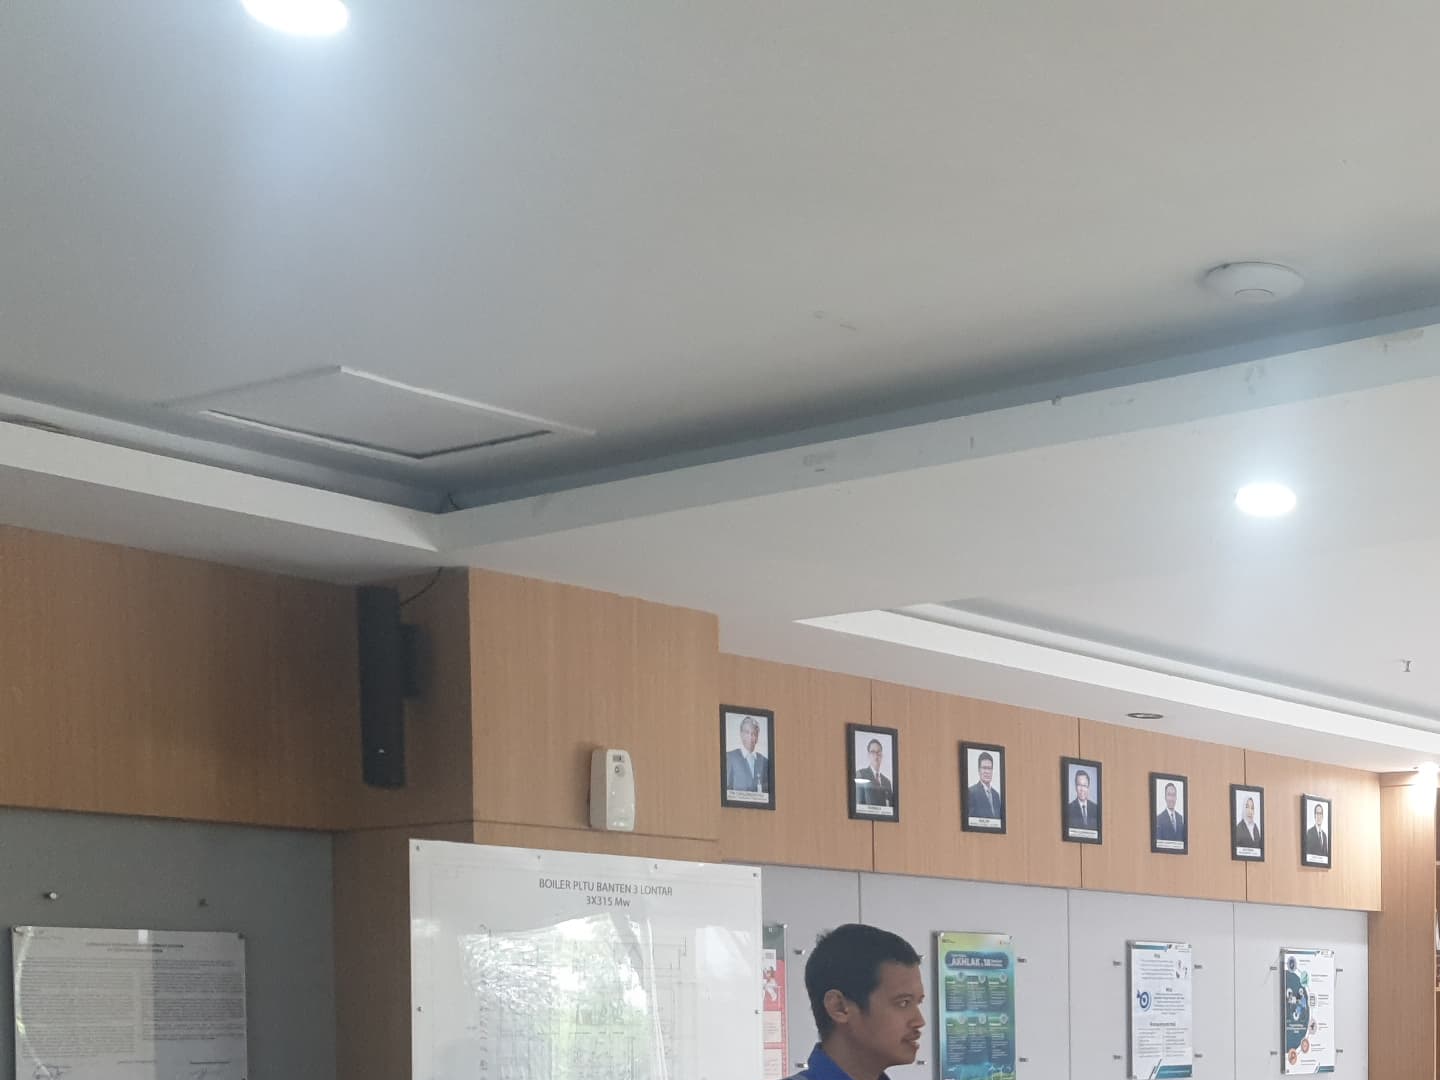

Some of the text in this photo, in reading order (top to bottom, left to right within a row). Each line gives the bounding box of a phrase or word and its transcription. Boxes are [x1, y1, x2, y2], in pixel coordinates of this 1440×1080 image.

[539, 878, 571, 890] BOILER
[573, 881, 595, 892] PLTU
[596, 882, 632, 895] BANTEN
[640, 885, 673, 897] LONTAR
[586, 895, 632, 908] 3X315 Mw
